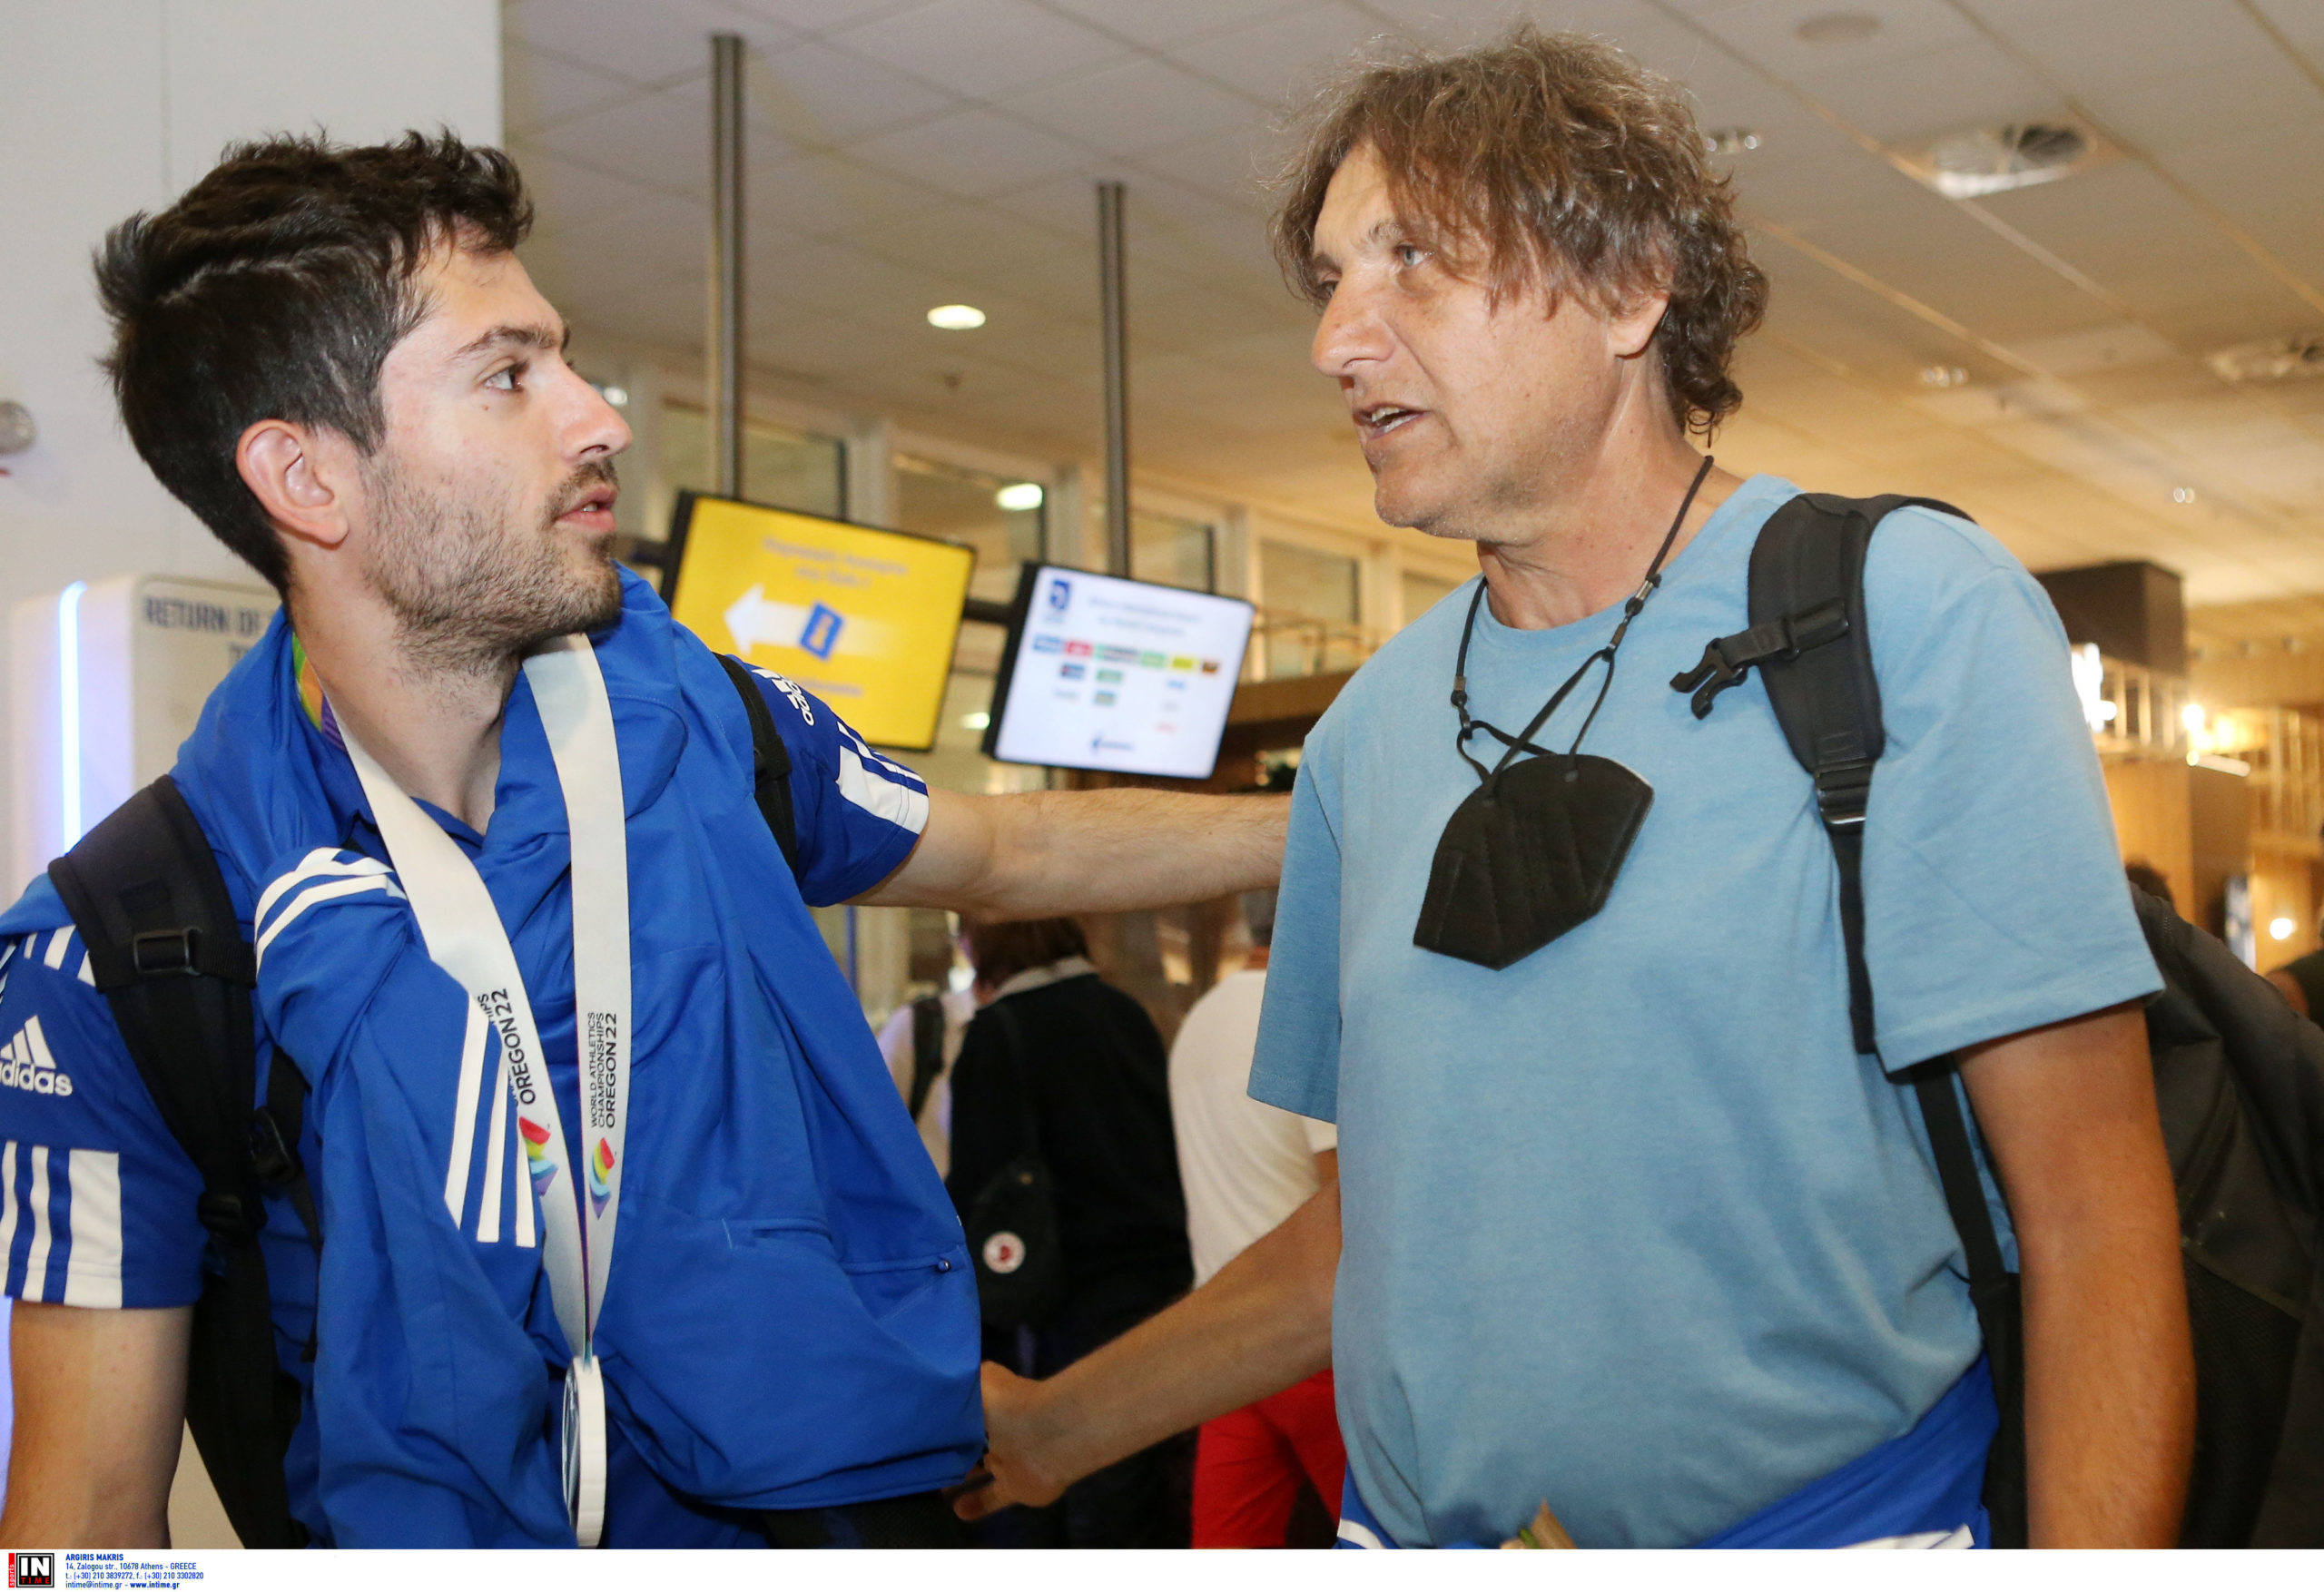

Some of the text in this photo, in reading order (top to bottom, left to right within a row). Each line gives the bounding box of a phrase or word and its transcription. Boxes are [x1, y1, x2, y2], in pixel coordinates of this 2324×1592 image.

[145, 596, 229, 634] RETURN
[588, 1012, 596, 1079] ATHLETICS
[596, 1012, 606, 1128] CHAMPIONSHIPS
[0, 1058, 74, 1096] didas
